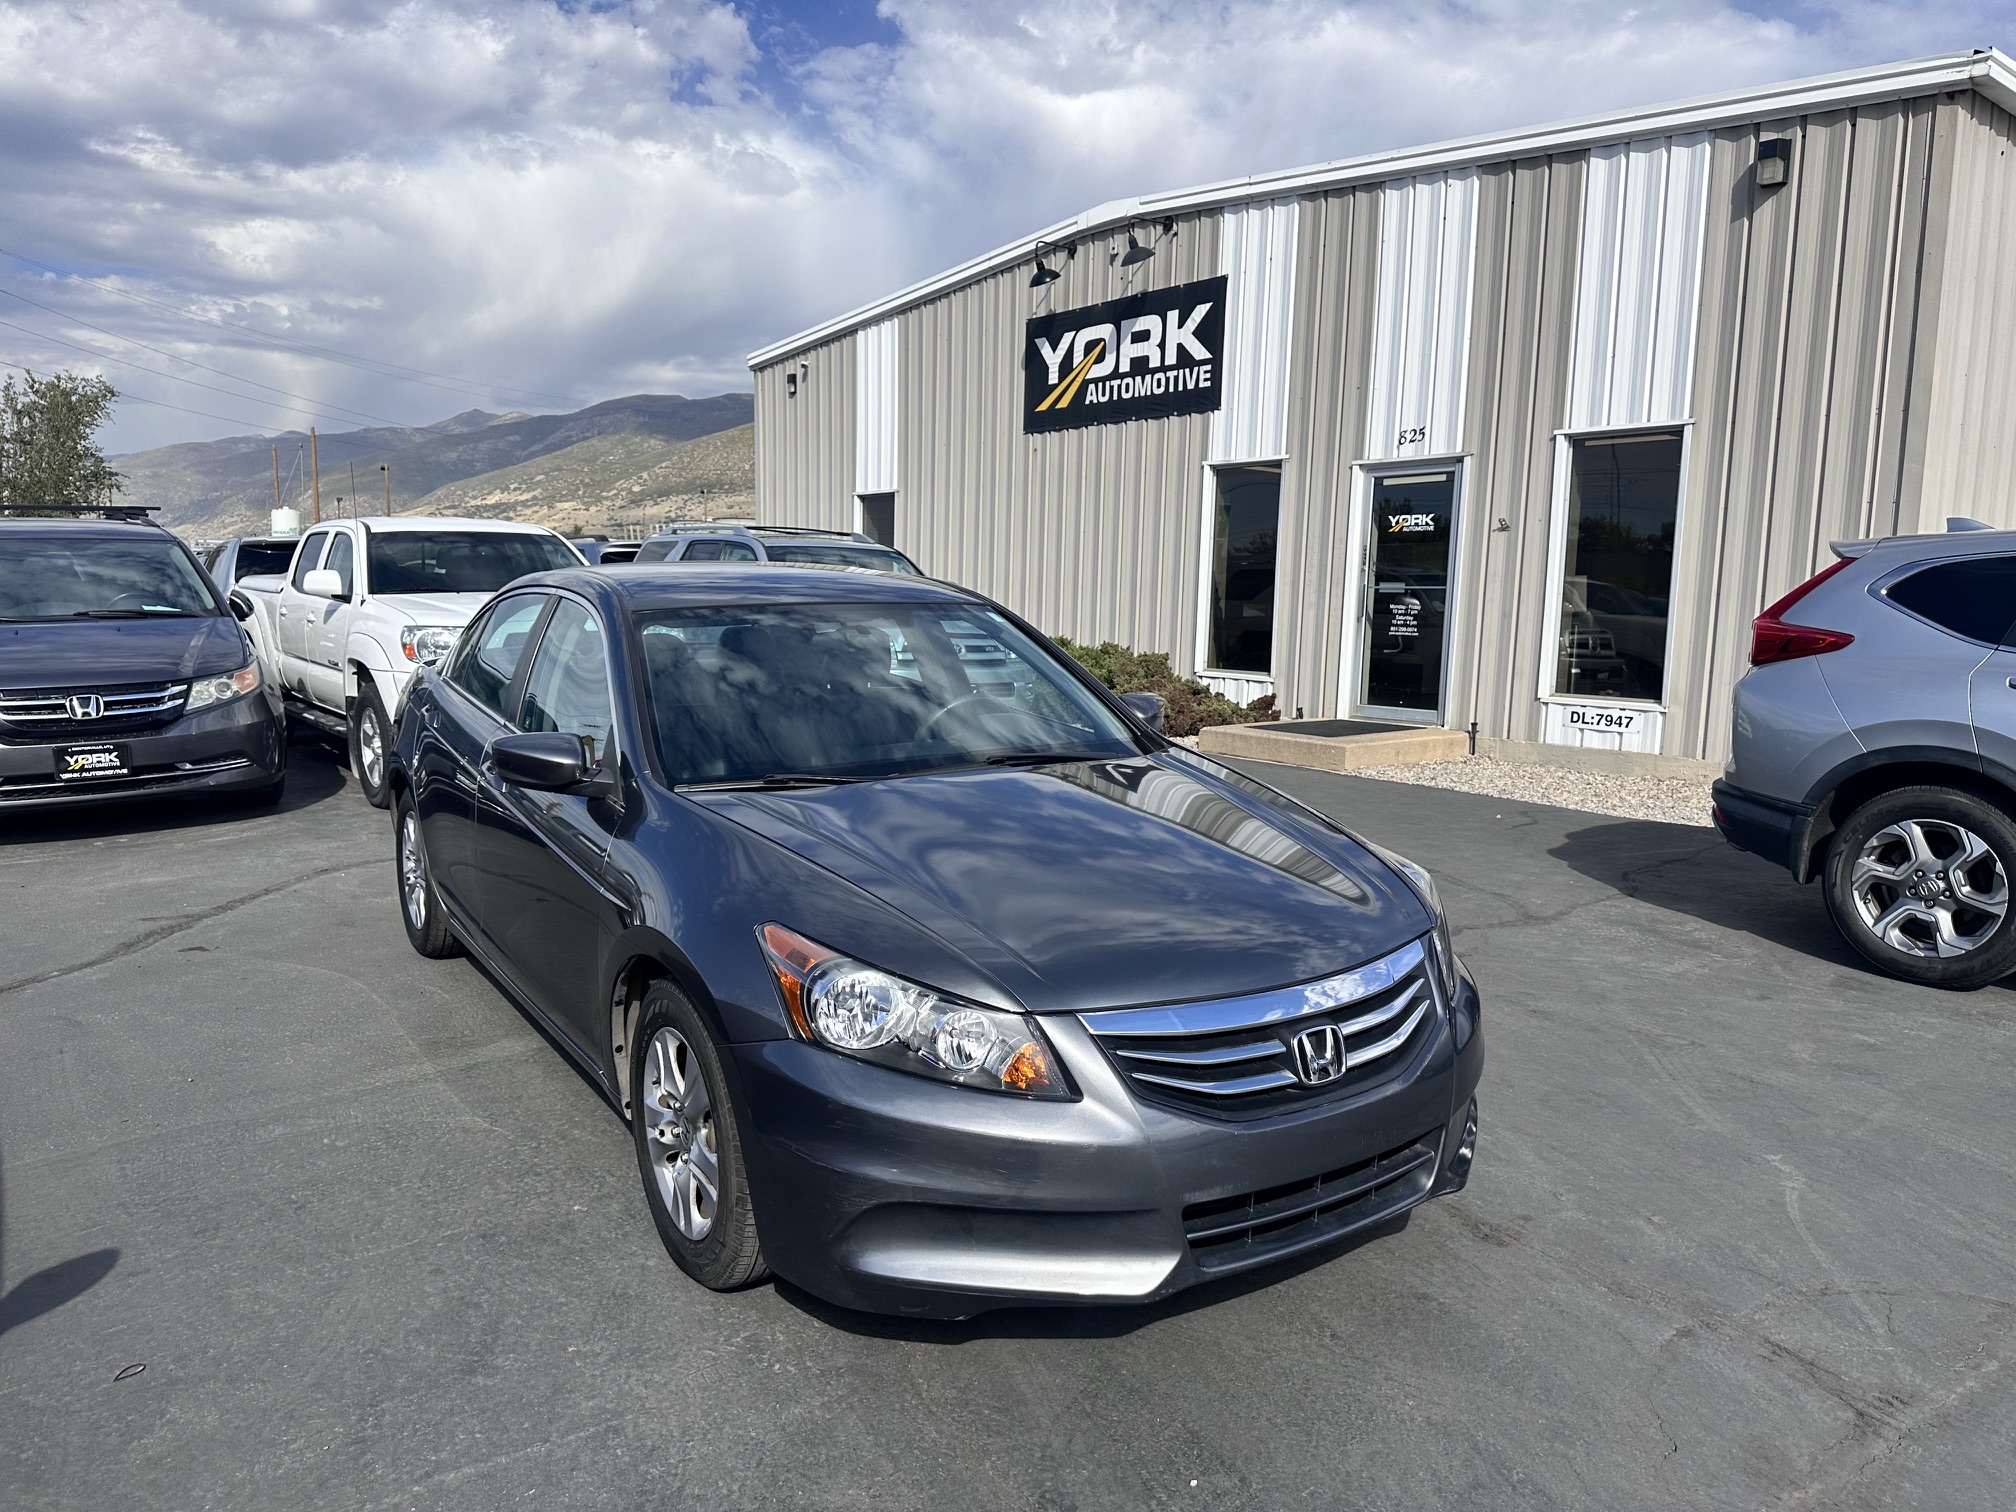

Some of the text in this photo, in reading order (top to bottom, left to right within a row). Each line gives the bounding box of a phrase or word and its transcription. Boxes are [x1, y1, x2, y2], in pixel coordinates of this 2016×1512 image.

[1034, 302, 1214, 385] YORK
[1084, 364, 1212, 405] AUTOMOTIVE
[1398, 425, 1426, 446] 825
[1387, 513, 1435, 527] YORK
[1570, 711, 1634, 729] DL:7947
[64, 751, 119, 766] YORK
[84, 761, 120, 769] AUTOMOTIVE
[81, 768, 128, 777] AUTOMOTIVE
